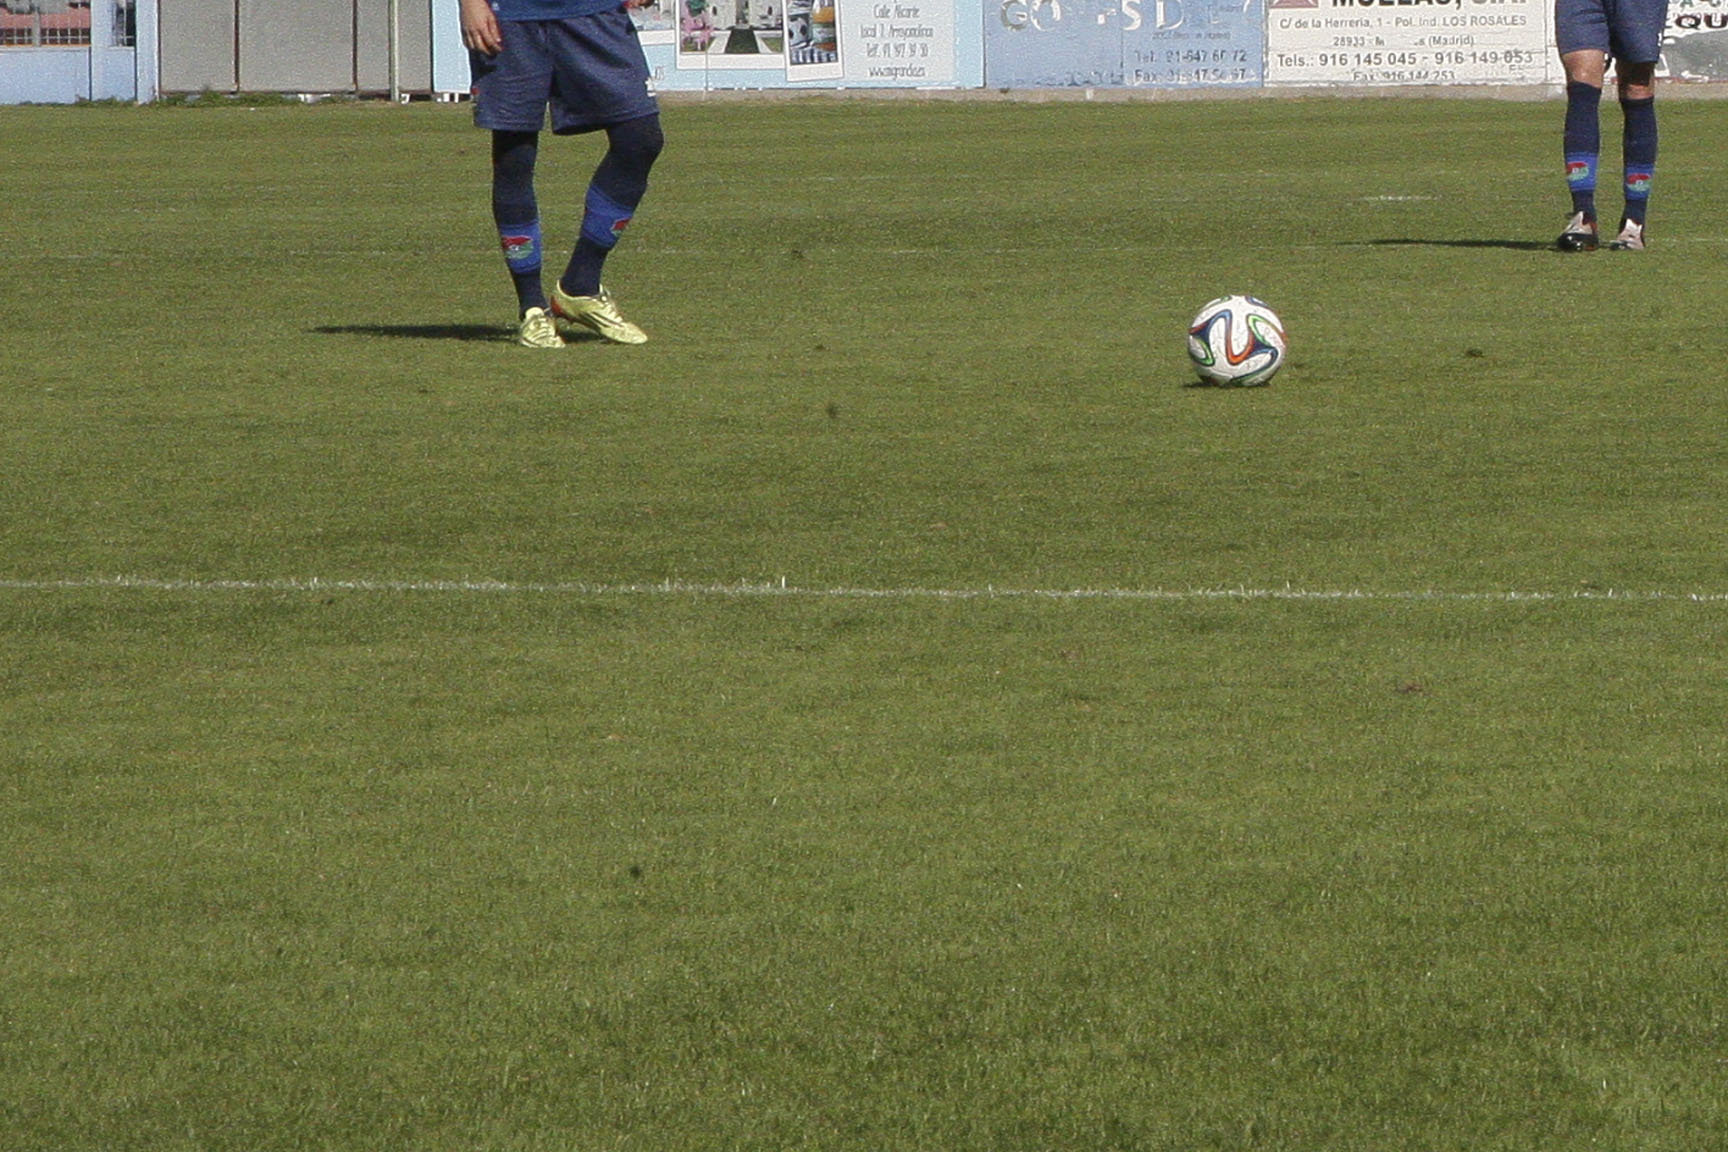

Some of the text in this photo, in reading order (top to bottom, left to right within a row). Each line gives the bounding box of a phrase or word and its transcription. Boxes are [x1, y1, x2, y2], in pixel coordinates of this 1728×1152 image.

[1294, 18, 1308, 29] de
[1312, 18, 1321, 28] la
[1395, 17, 1416, 27] Pol.
[1442, 16, 1467, 26] LOS
[1470, 15, 1527, 26] ROSALES
[1319, 53, 1348, 66] 916
[1355, 53, 1383, 66] 145
[1388, 52, 1417, 65] 045
[1435, 52, 1464, 65] 916
[1470, 52, 1498, 64] 149
